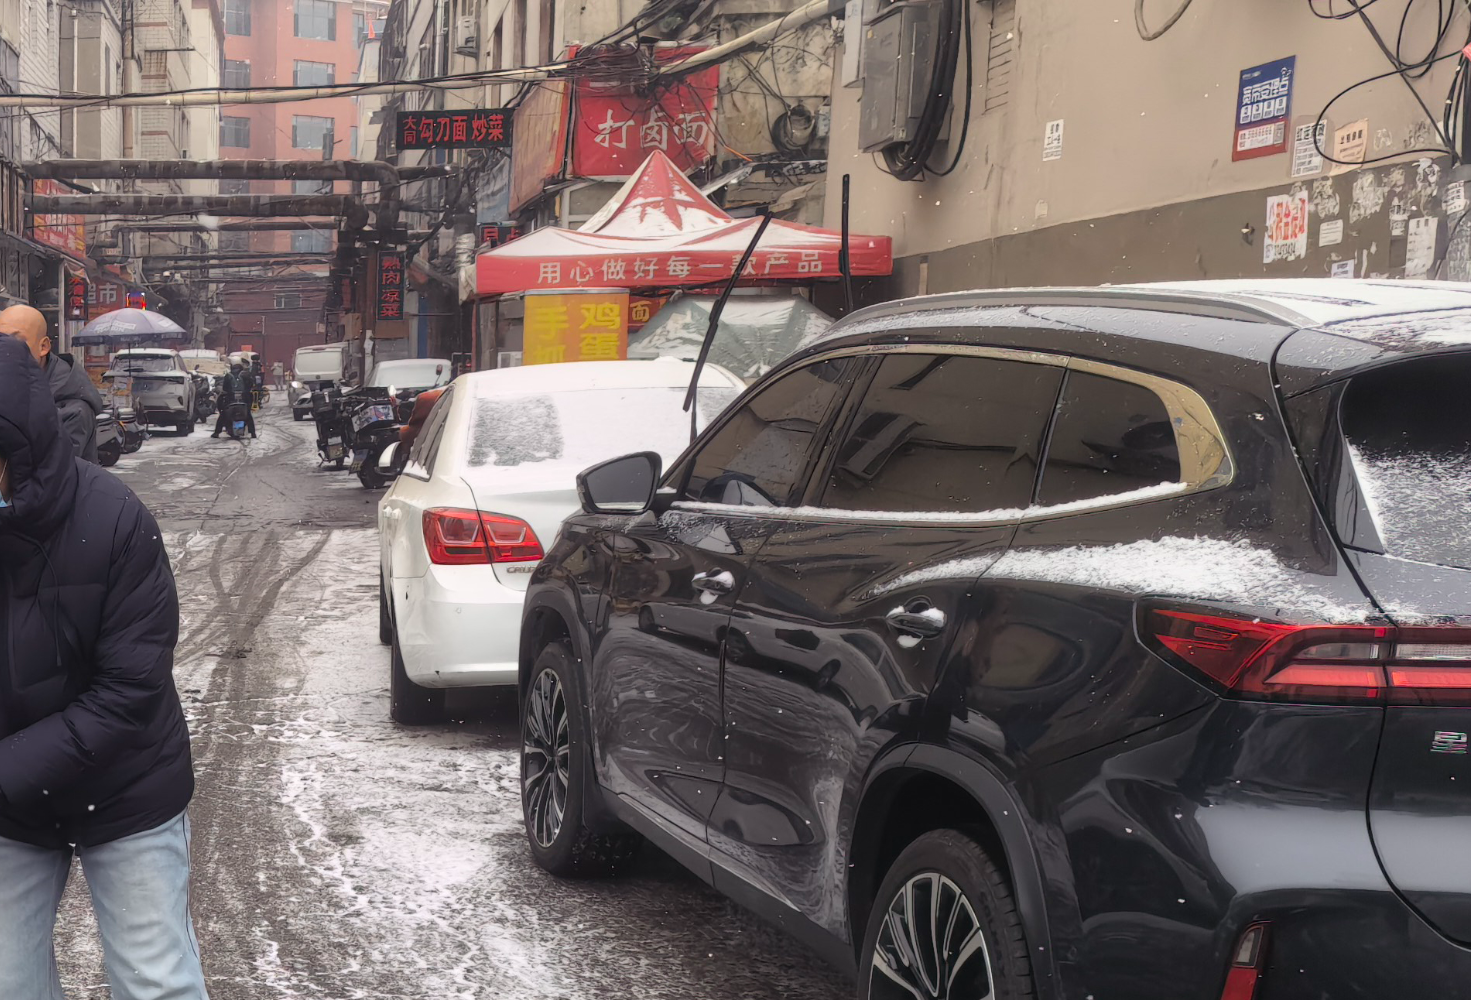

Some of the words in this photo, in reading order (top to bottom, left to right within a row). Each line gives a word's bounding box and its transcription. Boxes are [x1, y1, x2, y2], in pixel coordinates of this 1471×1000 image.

[403, 115, 418, 145] 大同
[594, 105, 710, 151] 打卤面
[537, 250, 823, 285] 用心做好每一款产品
[579, 302, 621, 359] 鸡蛋
